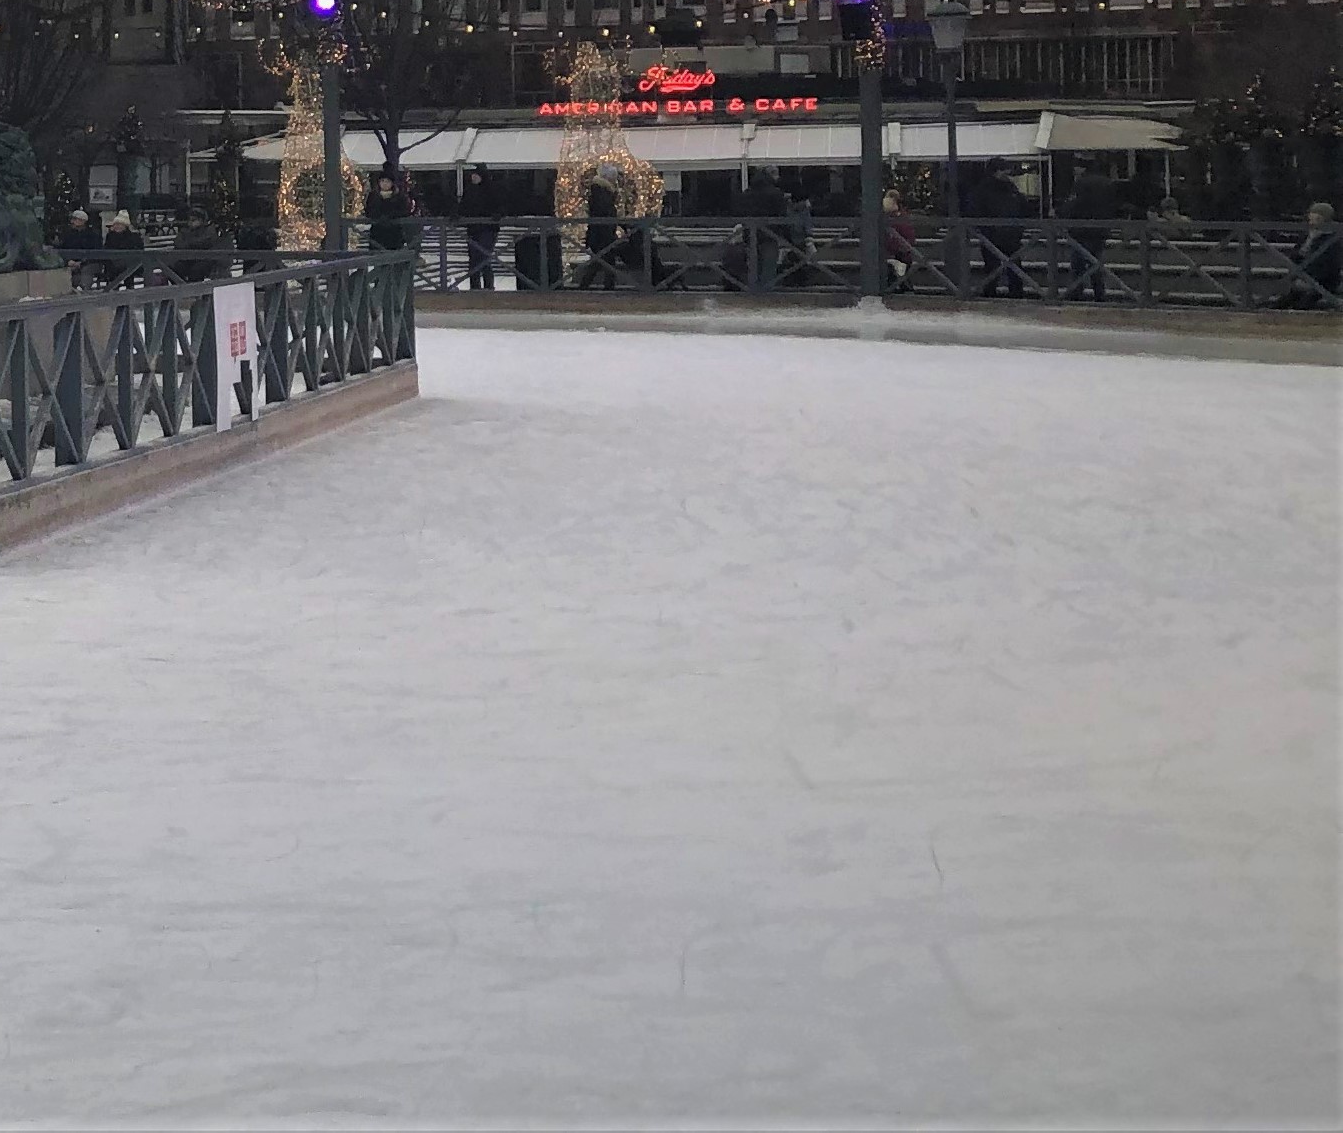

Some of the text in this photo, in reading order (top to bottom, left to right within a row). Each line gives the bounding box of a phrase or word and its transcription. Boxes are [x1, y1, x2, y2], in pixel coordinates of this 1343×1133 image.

[539, 97, 818, 115] AMERICAN BAR & CAFE
